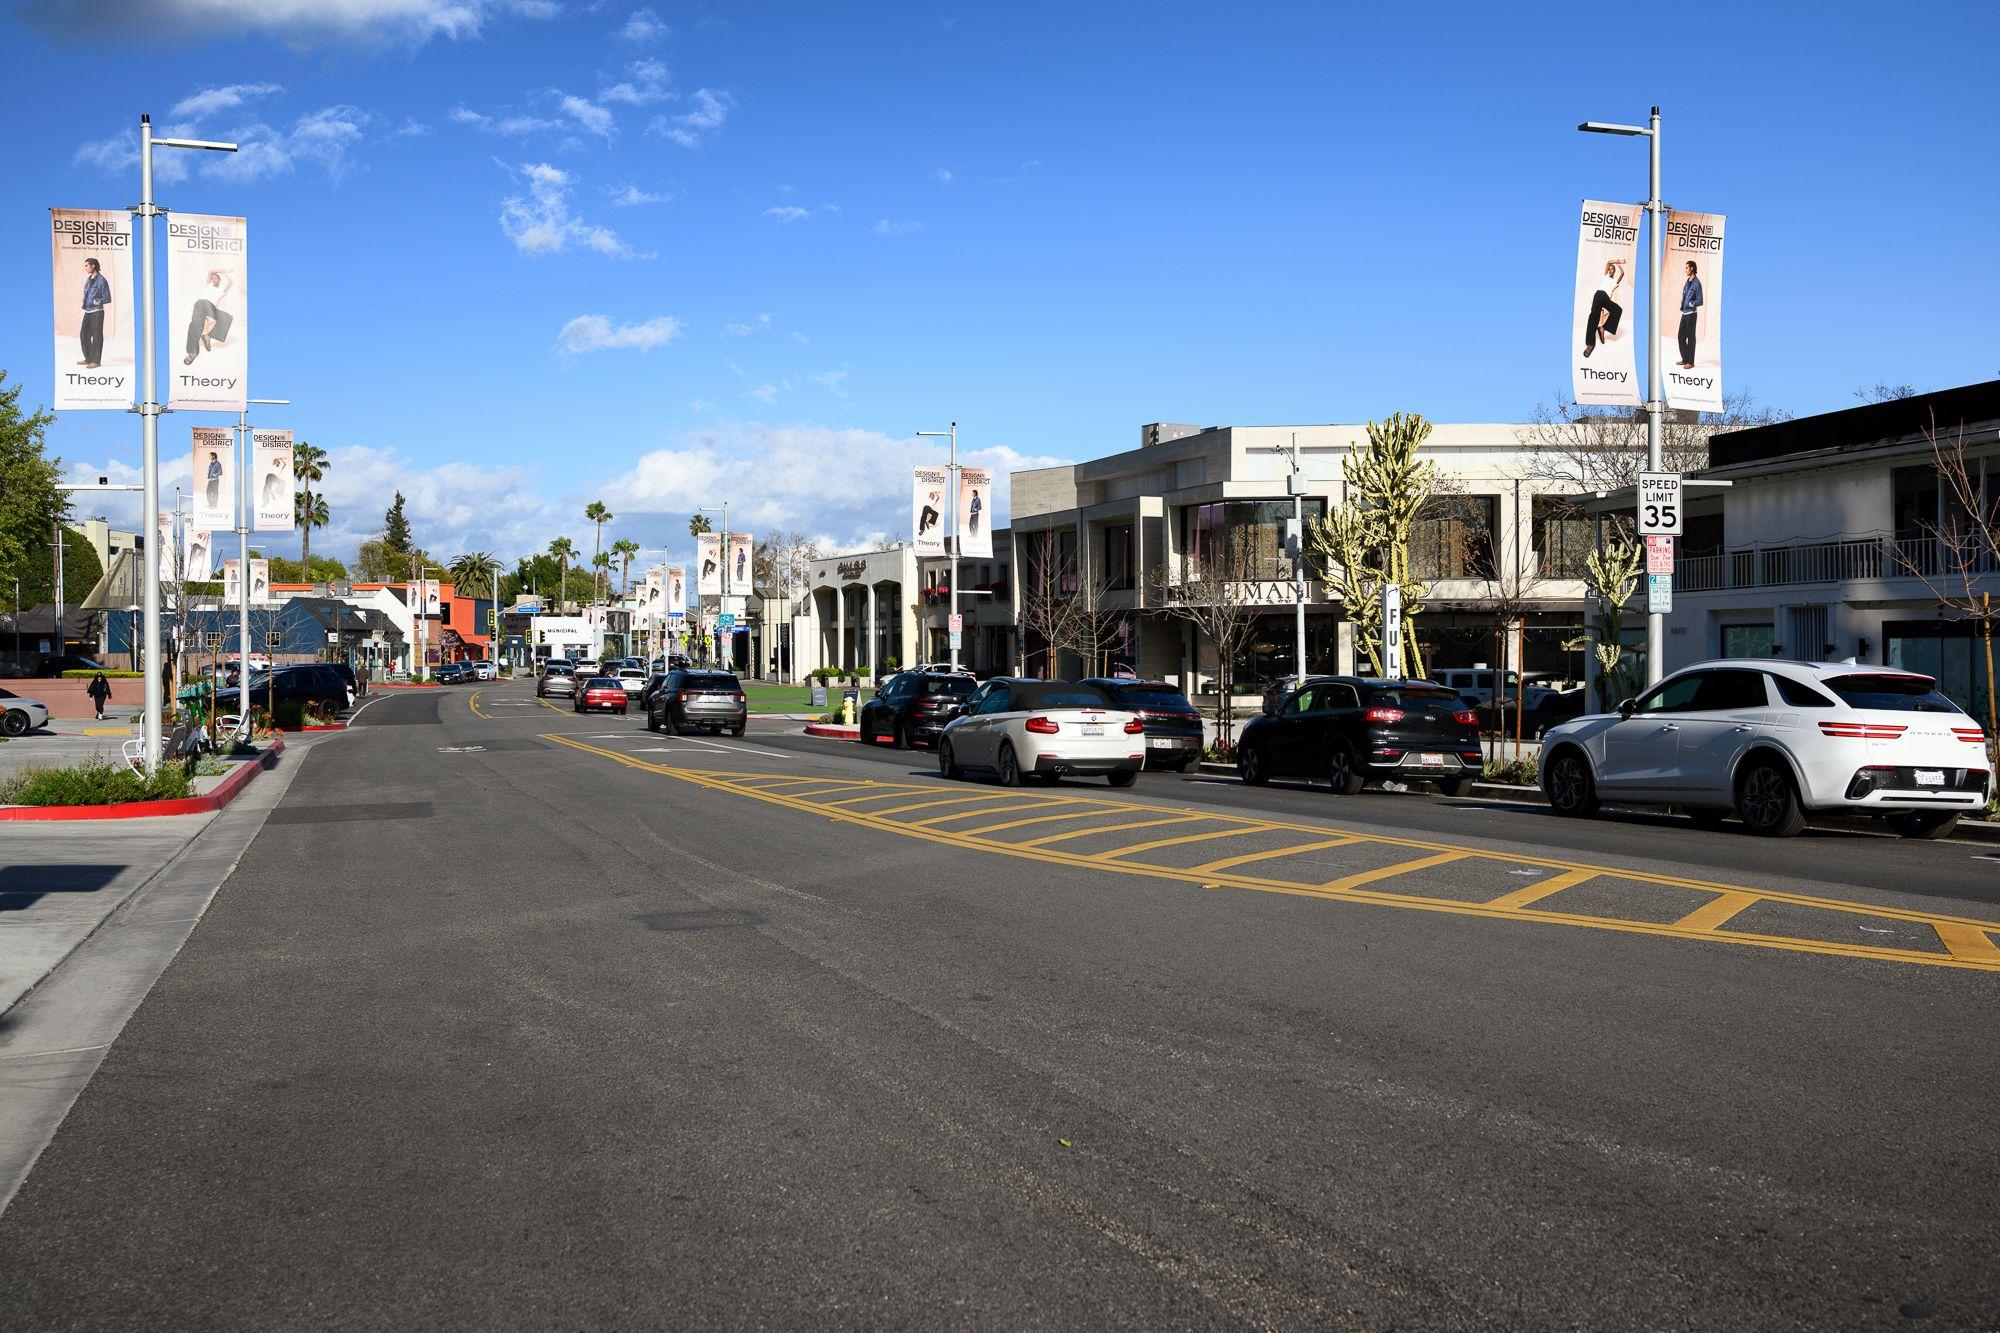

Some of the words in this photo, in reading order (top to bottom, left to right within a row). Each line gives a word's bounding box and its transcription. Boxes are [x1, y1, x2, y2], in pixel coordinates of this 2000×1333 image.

[1583, 212, 1621, 225] DESIGN
[54, 220, 105, 231] DESIGN
[169, 224, 220, 236] DESIGN
[1667, 221, 1706, 234] DESIGN
[72, 233, 130, 246] DISTRICT
[1594, 227, 1637, 241] DISTRICT
[188, 238, 243, 251] DISTRICT
[1678, 237, 1722, 250] DISTRICT
[66, 374, 124, 388] Theory
[180, 375, 237, 389] Theory
[1580, 368, 1628, 383] Theory
[1669, 373, 1713, 389] Theory
[1642, 480, 1678, 489] SPEED
[1646, 493, 1674, 502] LIMIT
[261, 512, 289, 520] Theory
[1644, 505, 1677, 528] 35
[1389, 608, 1398, 678] FUL
